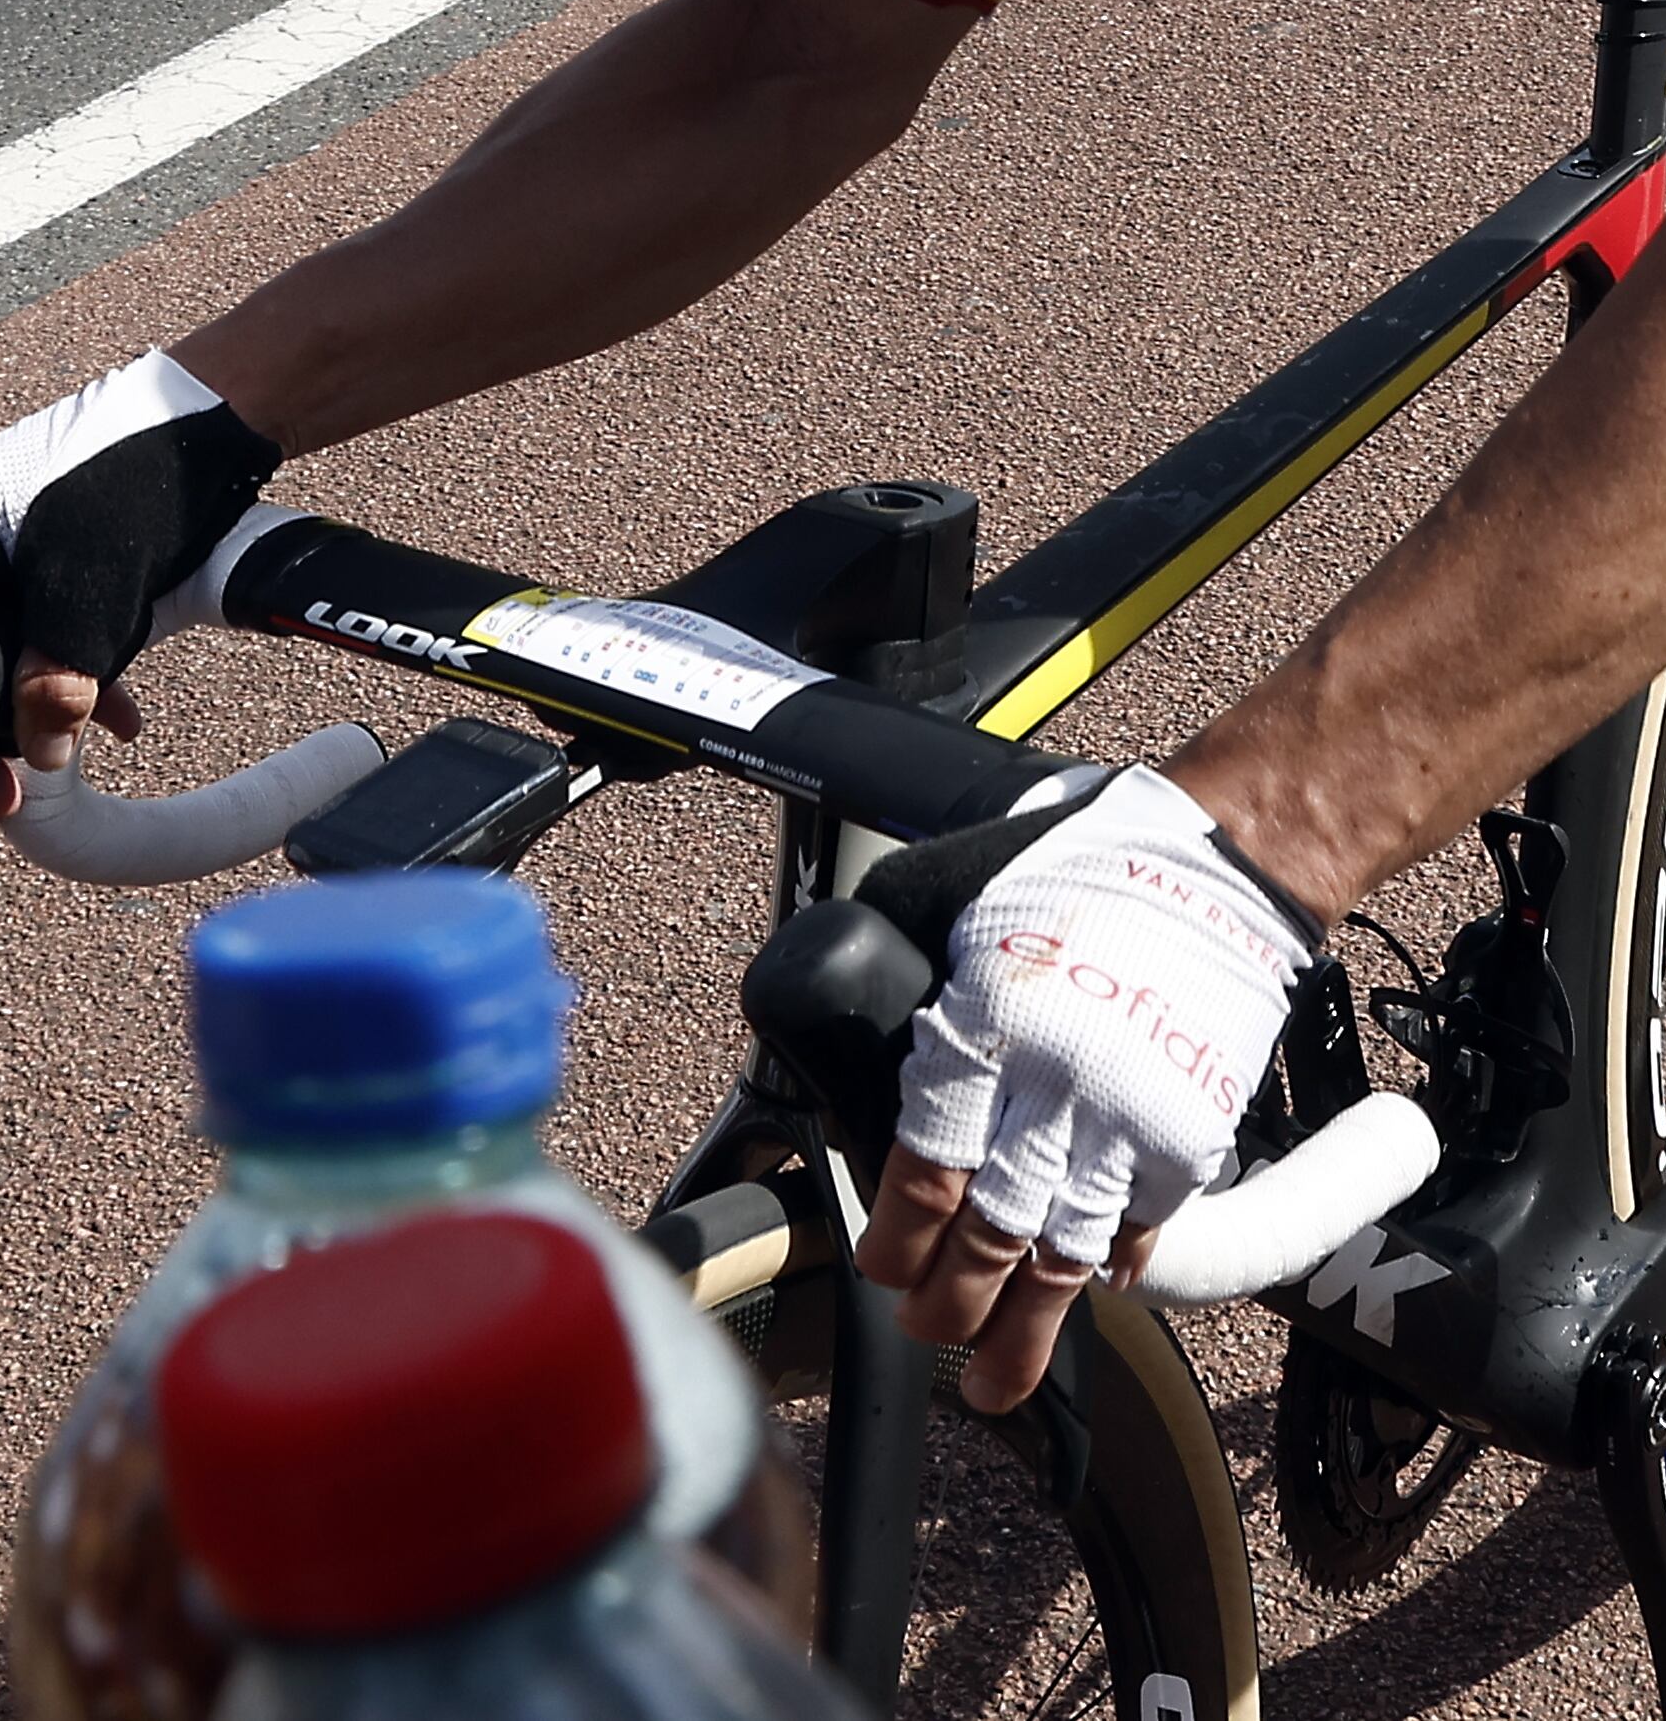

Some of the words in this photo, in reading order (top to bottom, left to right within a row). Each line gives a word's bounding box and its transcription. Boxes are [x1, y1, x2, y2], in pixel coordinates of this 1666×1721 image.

[303, 601, 488, 673] LOOK
[699, 737, 736, 761] COMBO
[737, 752, 766, 771] AERO
[766, 760, 823, 790] HANDLEBAR
[1126, 859, 1193, 904] VAN
[998, 929, 1239, 1116] Cofidis
